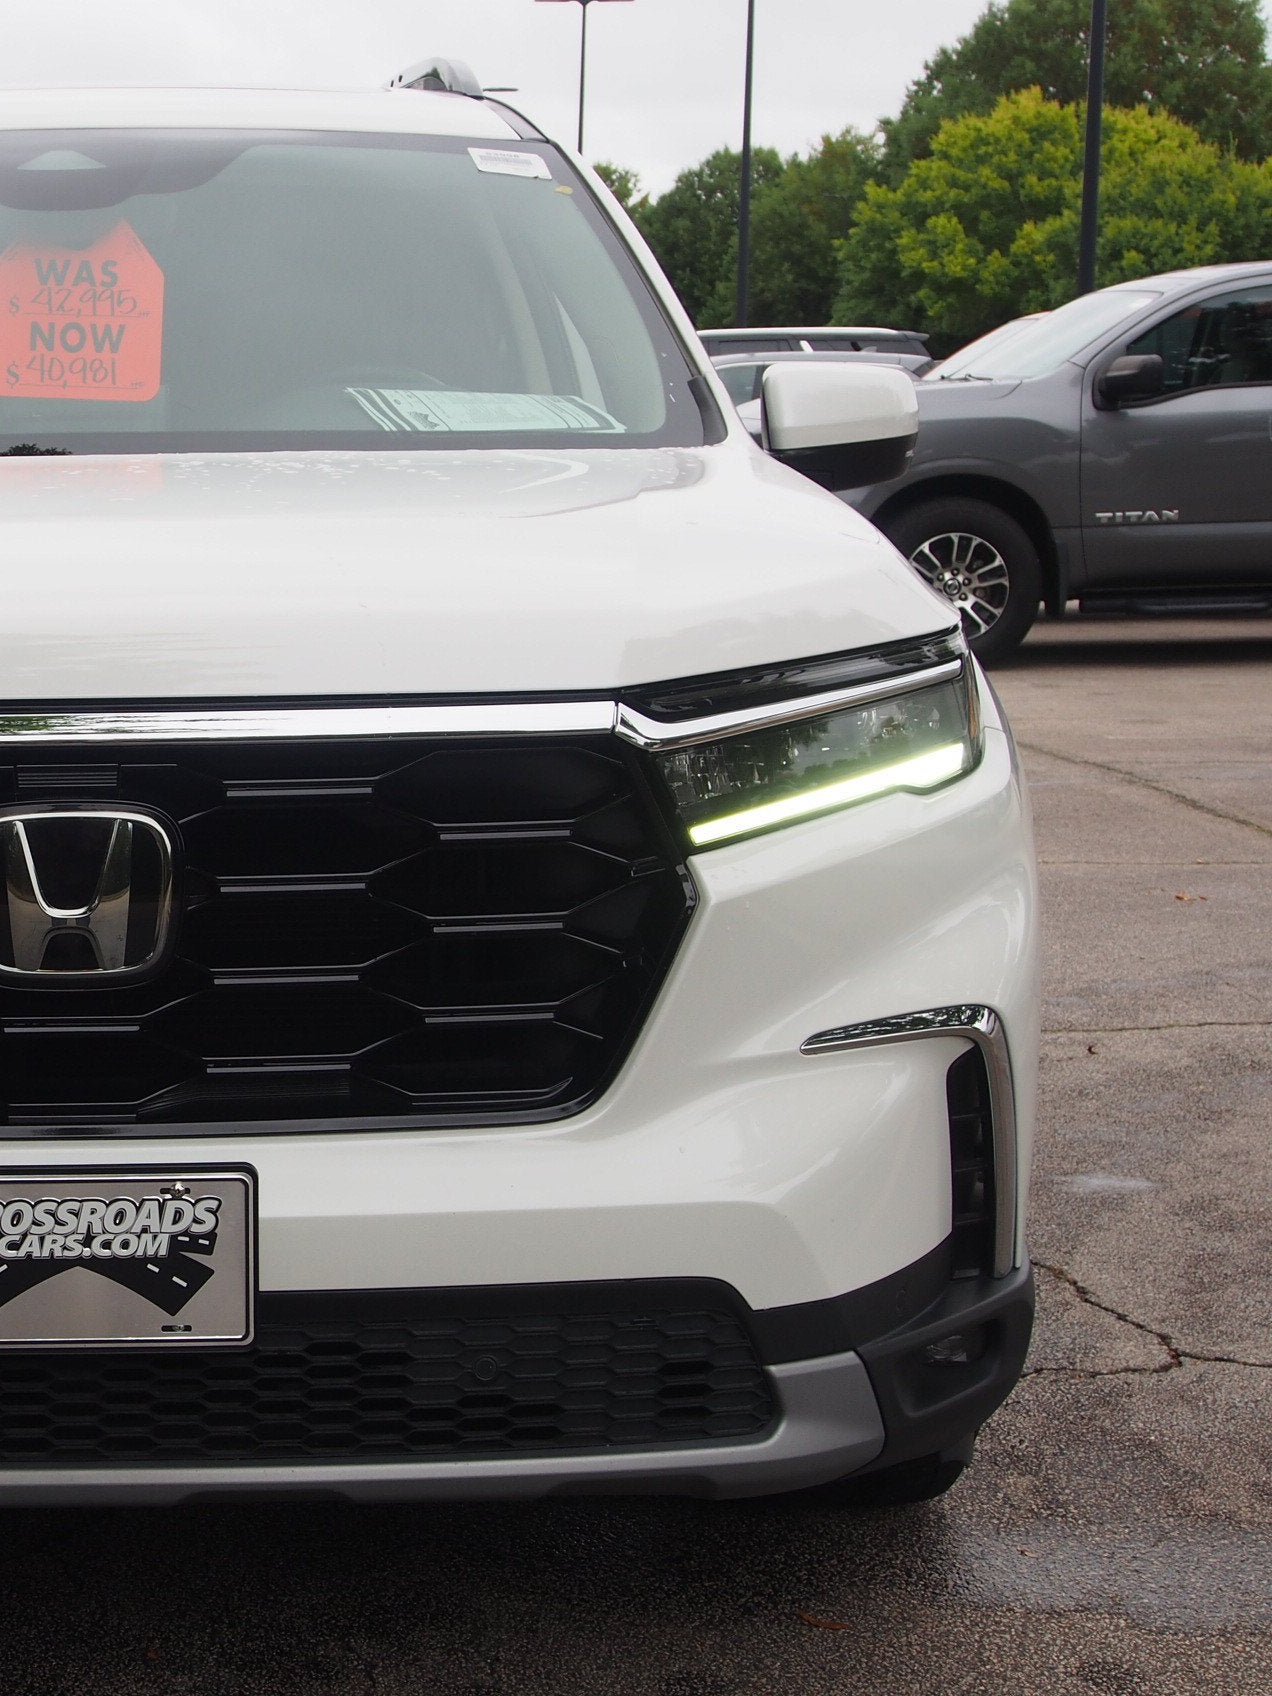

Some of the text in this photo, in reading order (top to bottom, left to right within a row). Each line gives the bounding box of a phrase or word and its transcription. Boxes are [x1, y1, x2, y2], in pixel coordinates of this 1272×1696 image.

[35, 258, 119, 288] WAS
[30, 321, 126, 353] NOW
[1095, 510, 1179, 523] TITAN
